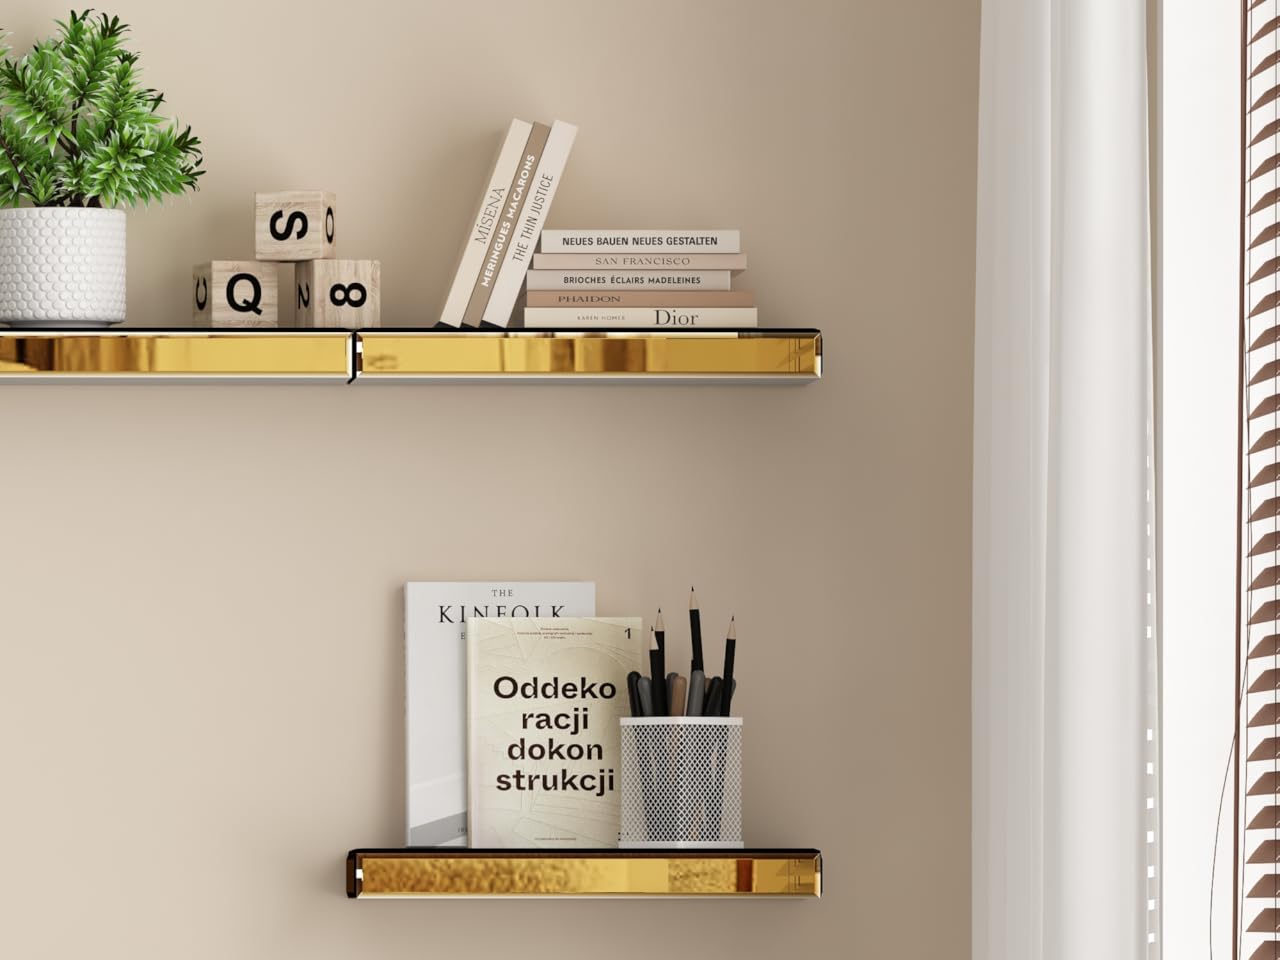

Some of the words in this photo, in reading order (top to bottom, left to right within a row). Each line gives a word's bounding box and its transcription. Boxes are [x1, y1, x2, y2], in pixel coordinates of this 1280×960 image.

[270, 210, 308, 241] S
[481, 221, 511, 287] MERINGUES
[506, 154, 536, 219] MACARONS
[512, 241, 529, 262] THE
[521, 215, 538, 240] THIN
[531, 173, 554, 215] JUSTICE
[562, 237, 594, 246] NEUES
[596, 237, 628, 246] BAUEN
[632, 237, 663, 246] NEUES
[666, 236, 718, 246] GESTALTEN
[595, 257, 618, 265] SAN
[623, 257, 691, 265] FRANCISCO
[563, 276, 606, 284] BRIOCHES
[610, 275, 645, 284] ÉCLAIRS
[648, 276, 701, 284] MADELEINES
[226, 273, 263, 315] Q
[330, 283, 367, 307] 8
[653, 309, 699, 326] Dior
[491, 589, 513, 597] THE
[437, 604, 566, 623] KINFOLK
[624, 627, 631, 639] 1
[493, 676, 617, 700] Oddeko
[521, 708, 590, 736] racji
[506, 738, 604, 761] dokon
[495, 769, 616, 797] strukcji
